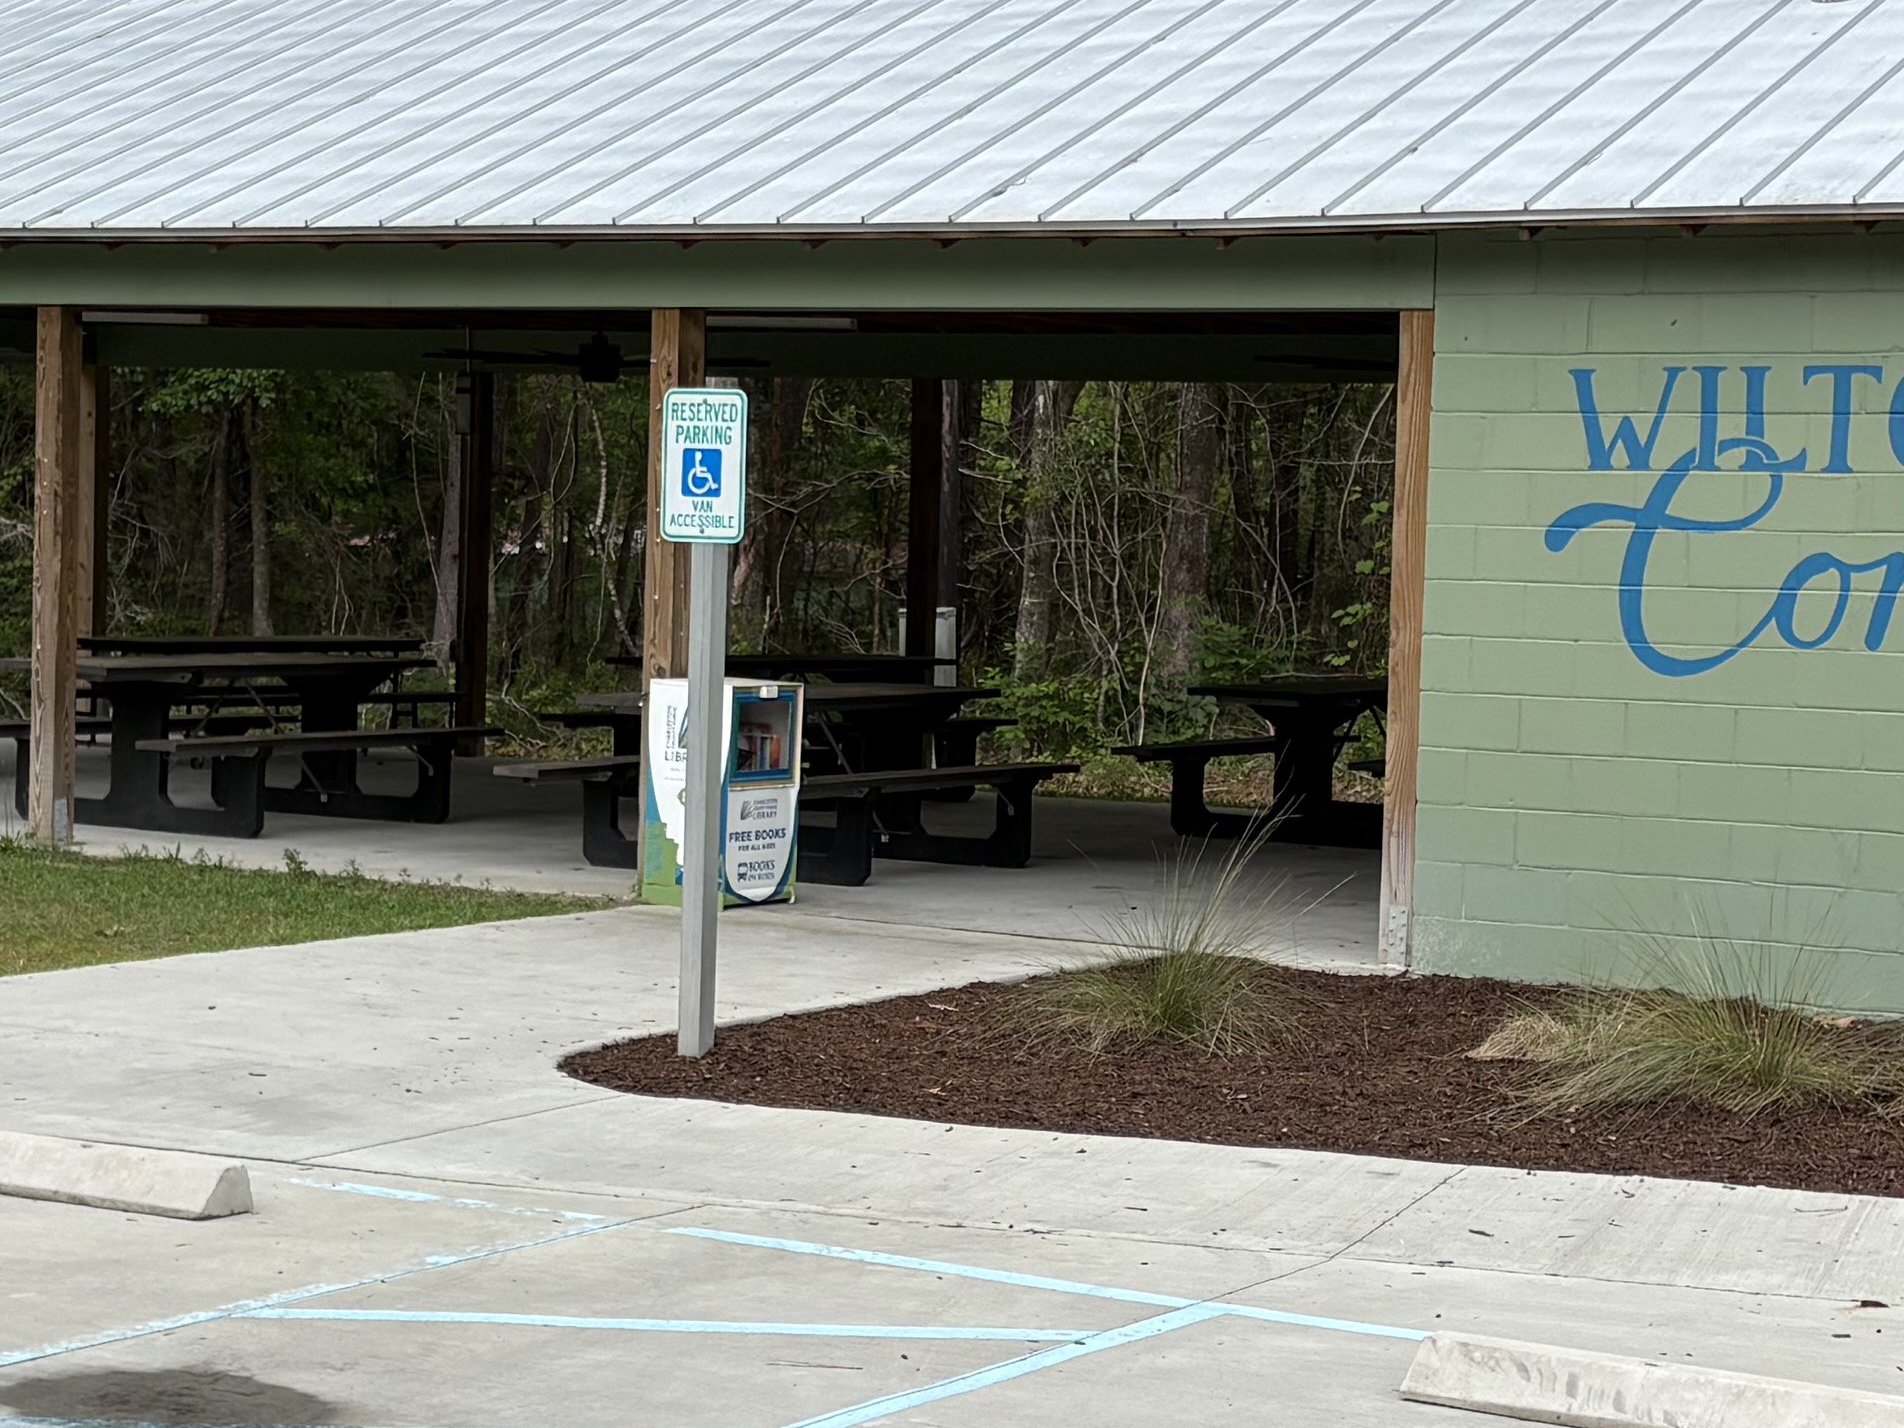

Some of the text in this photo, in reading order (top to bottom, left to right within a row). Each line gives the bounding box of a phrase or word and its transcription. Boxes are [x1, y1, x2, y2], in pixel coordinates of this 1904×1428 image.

[671, 402, 738, 423] RESERVED
[676, 425, 732, 445] PARKING
[692, 500, 713, 513] VAN
[670, 513, 735, 529] ACCESSIBLE
[729, 828, 786, 843] FREE BOOKS
